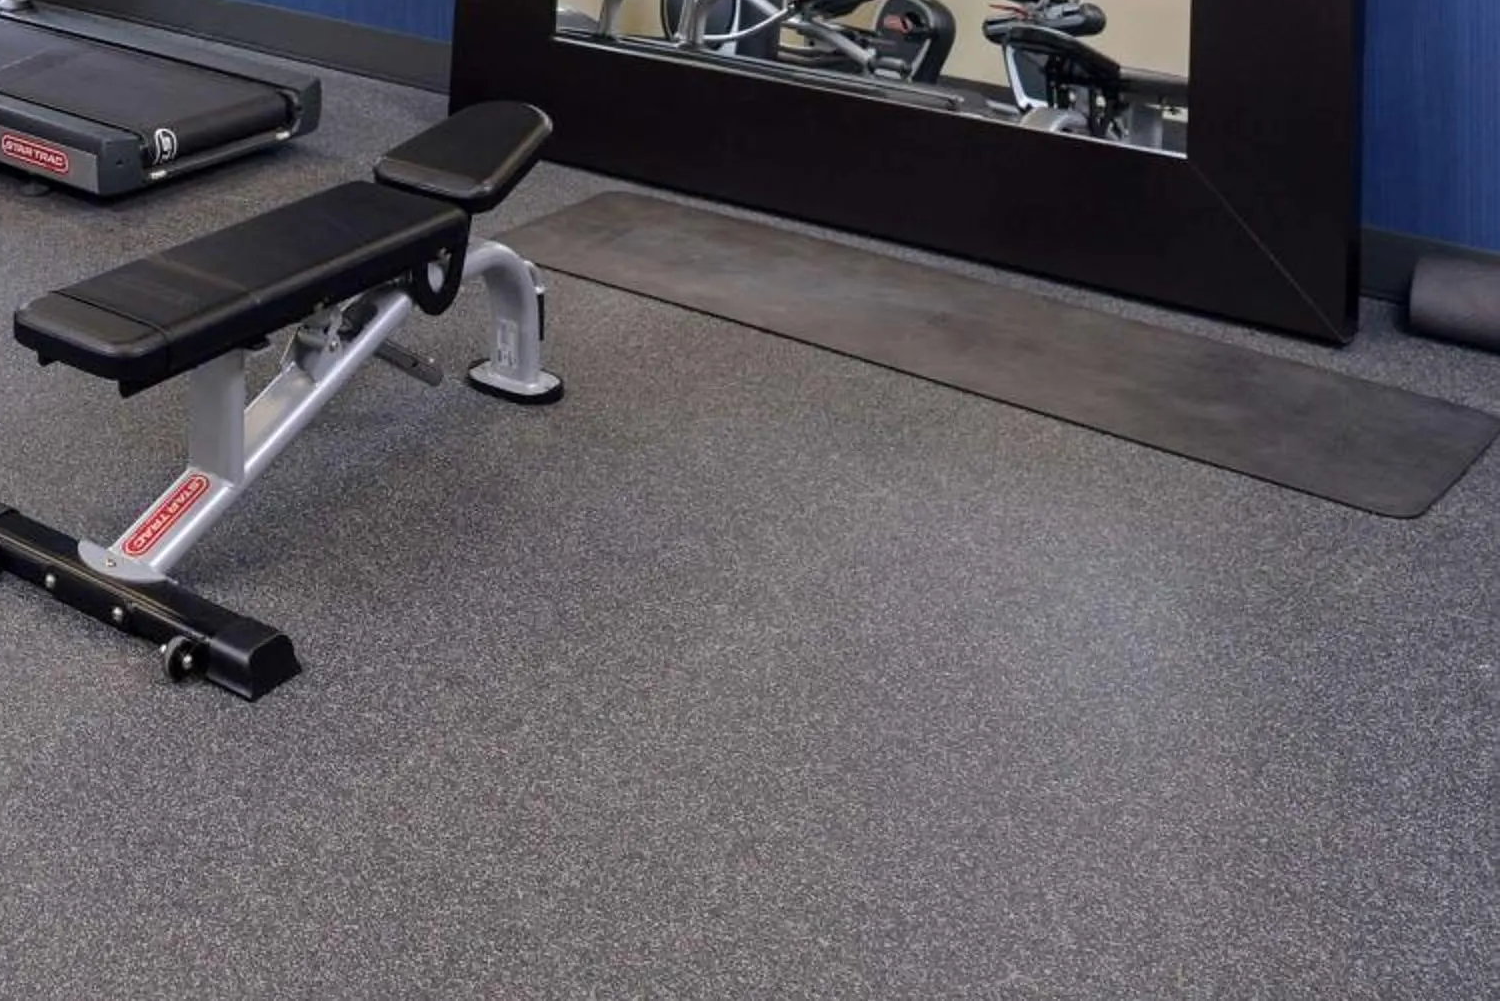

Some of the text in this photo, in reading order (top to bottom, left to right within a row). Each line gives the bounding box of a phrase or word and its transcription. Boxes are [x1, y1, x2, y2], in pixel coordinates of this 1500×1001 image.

[3, 140, 65, 167] STAR TRAC
[131, 478, 202, 549] STAR TRAC
